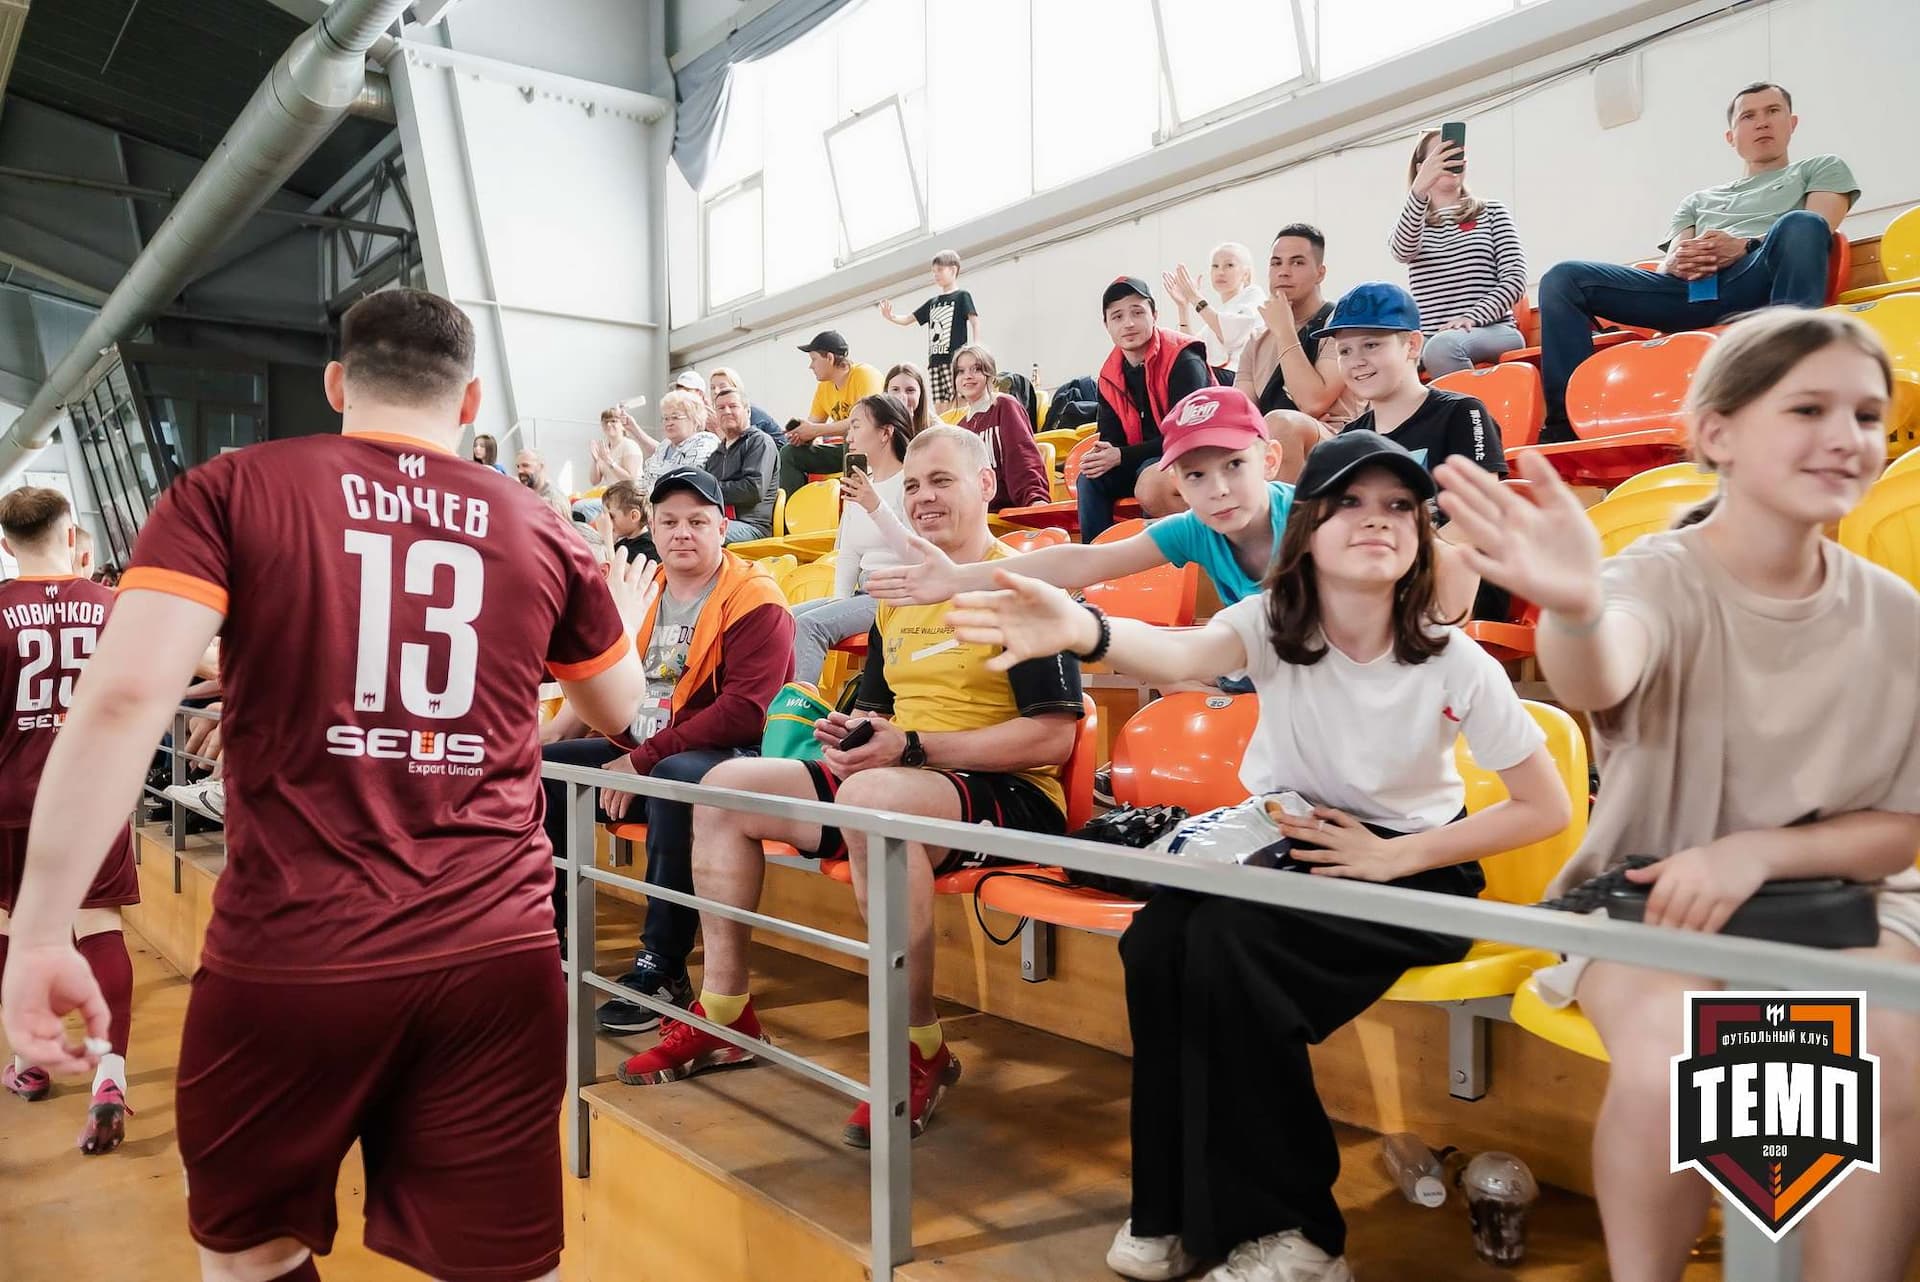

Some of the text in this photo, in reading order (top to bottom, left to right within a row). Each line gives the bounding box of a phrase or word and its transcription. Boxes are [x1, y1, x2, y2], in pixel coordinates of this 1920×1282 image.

[341, 474, 489, 538] СЫЧЕВ
[2, 601, 105, 629] НОВИЧКОВ
[344, 529, 485, 719] 13
[16, 627, 97, 712] 25
[17, 712, 69, 731] SEU
[326, 725, 485, 763] SEUS
[408, 761, 483, 777] Export Union
